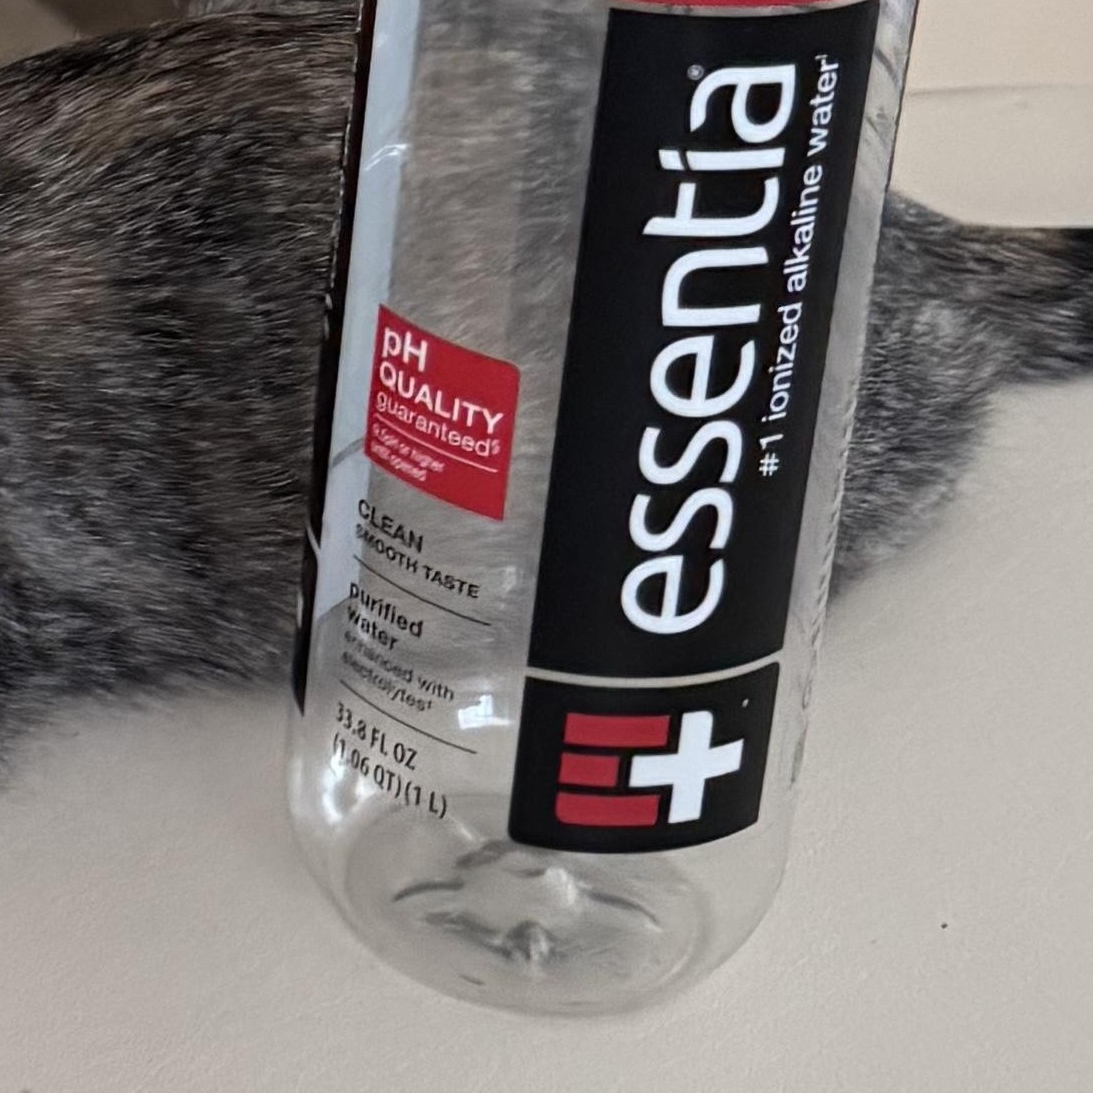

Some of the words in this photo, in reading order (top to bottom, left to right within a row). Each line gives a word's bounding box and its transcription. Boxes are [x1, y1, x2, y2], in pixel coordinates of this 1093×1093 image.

[783, 164, 823, 294] alkaline
[382, 327, 428, 372] pH
[620, 63, 796, 634] essentia
[761, 302, 803, 422] ionized
[379, 361, 503, 434] QUALITY
[759, 433, 784, 477] #1
[358, 499, 424, 553] CLEAN
[355, 523, 418, 574] SMOOTH
[424, 565, 482, 599] TASTE
[347, 605, 399, 650] water
[349, 582, 424, 638] purified
[417, 676, 454, 701] with
[336, 702, 367, 741] 33.8
[370, 727, 388, 756] FL
[393, 742, 418, 770] OZ
[429, 790, 447, 819] L)
